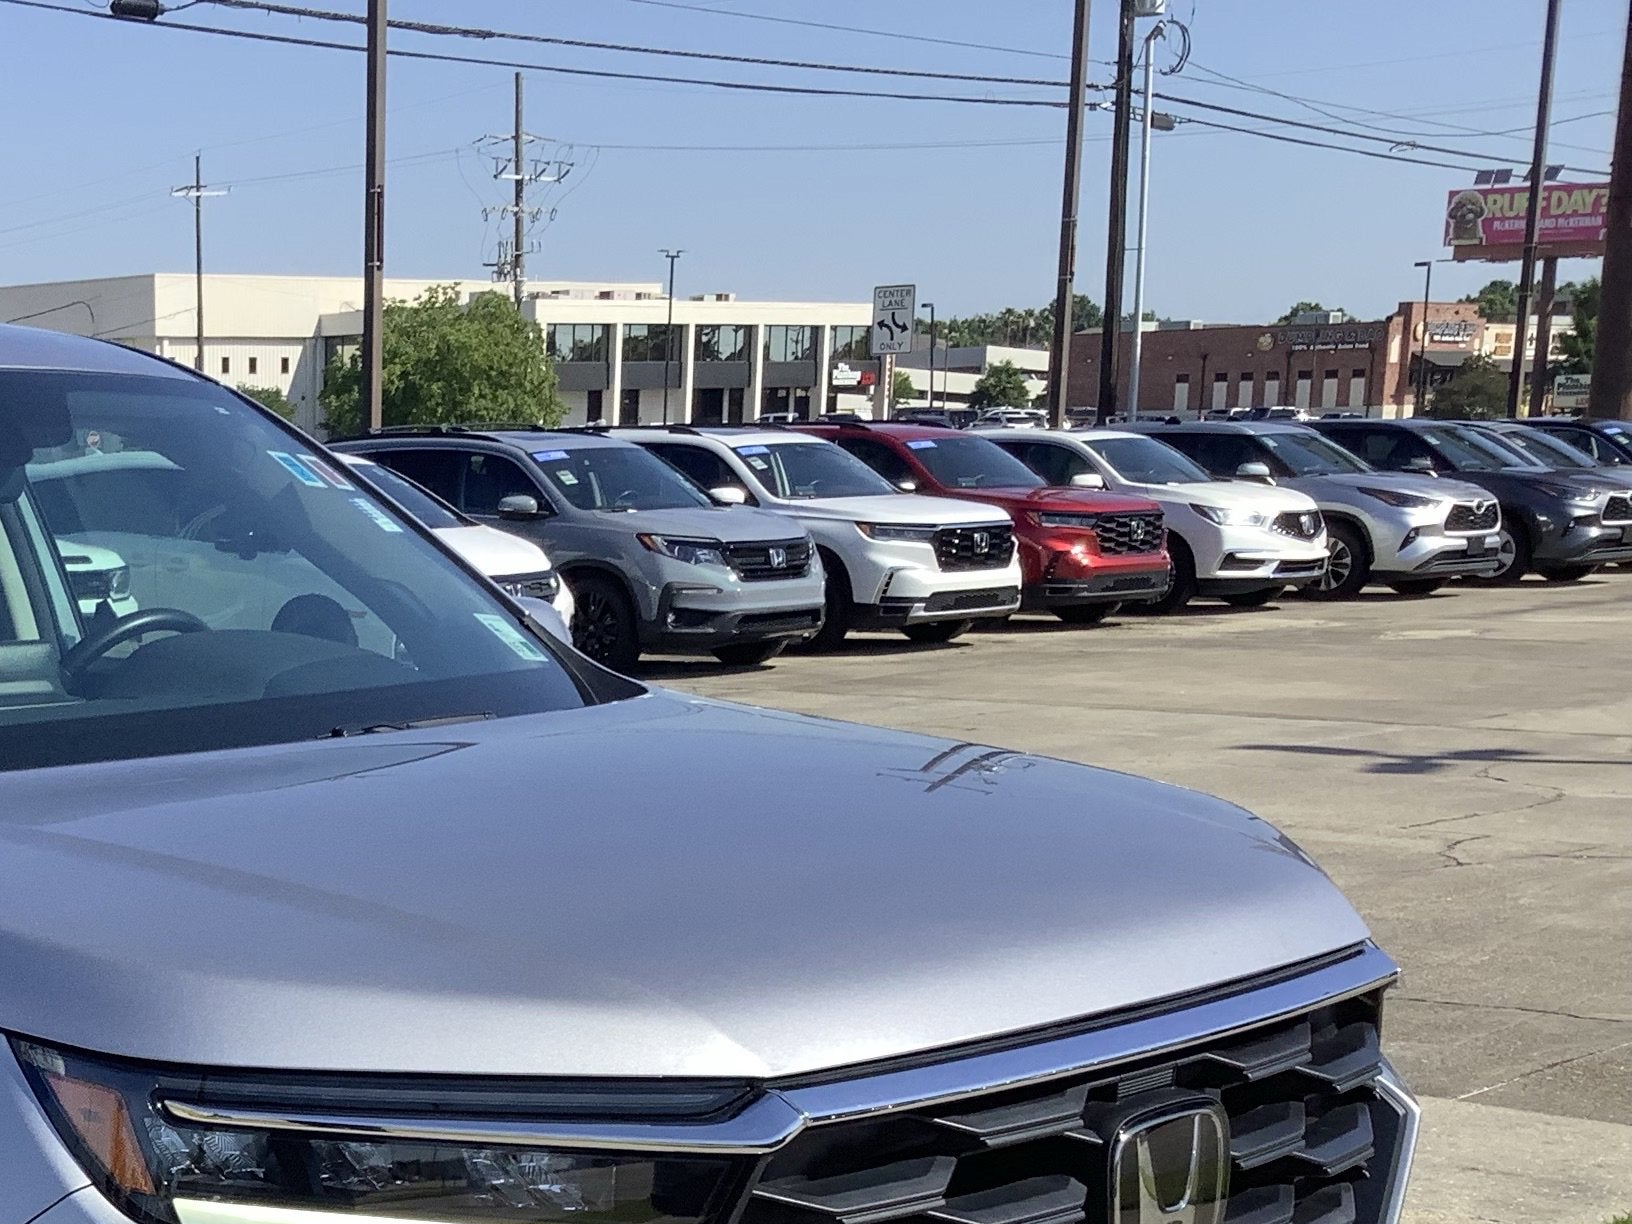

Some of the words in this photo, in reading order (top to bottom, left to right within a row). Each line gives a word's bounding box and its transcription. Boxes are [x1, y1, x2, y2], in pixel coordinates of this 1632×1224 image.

[877, 289, 912, 299] CENTER
[882, 299, 905, 308] LANE
[880, 341, 904, 351] ONLY
